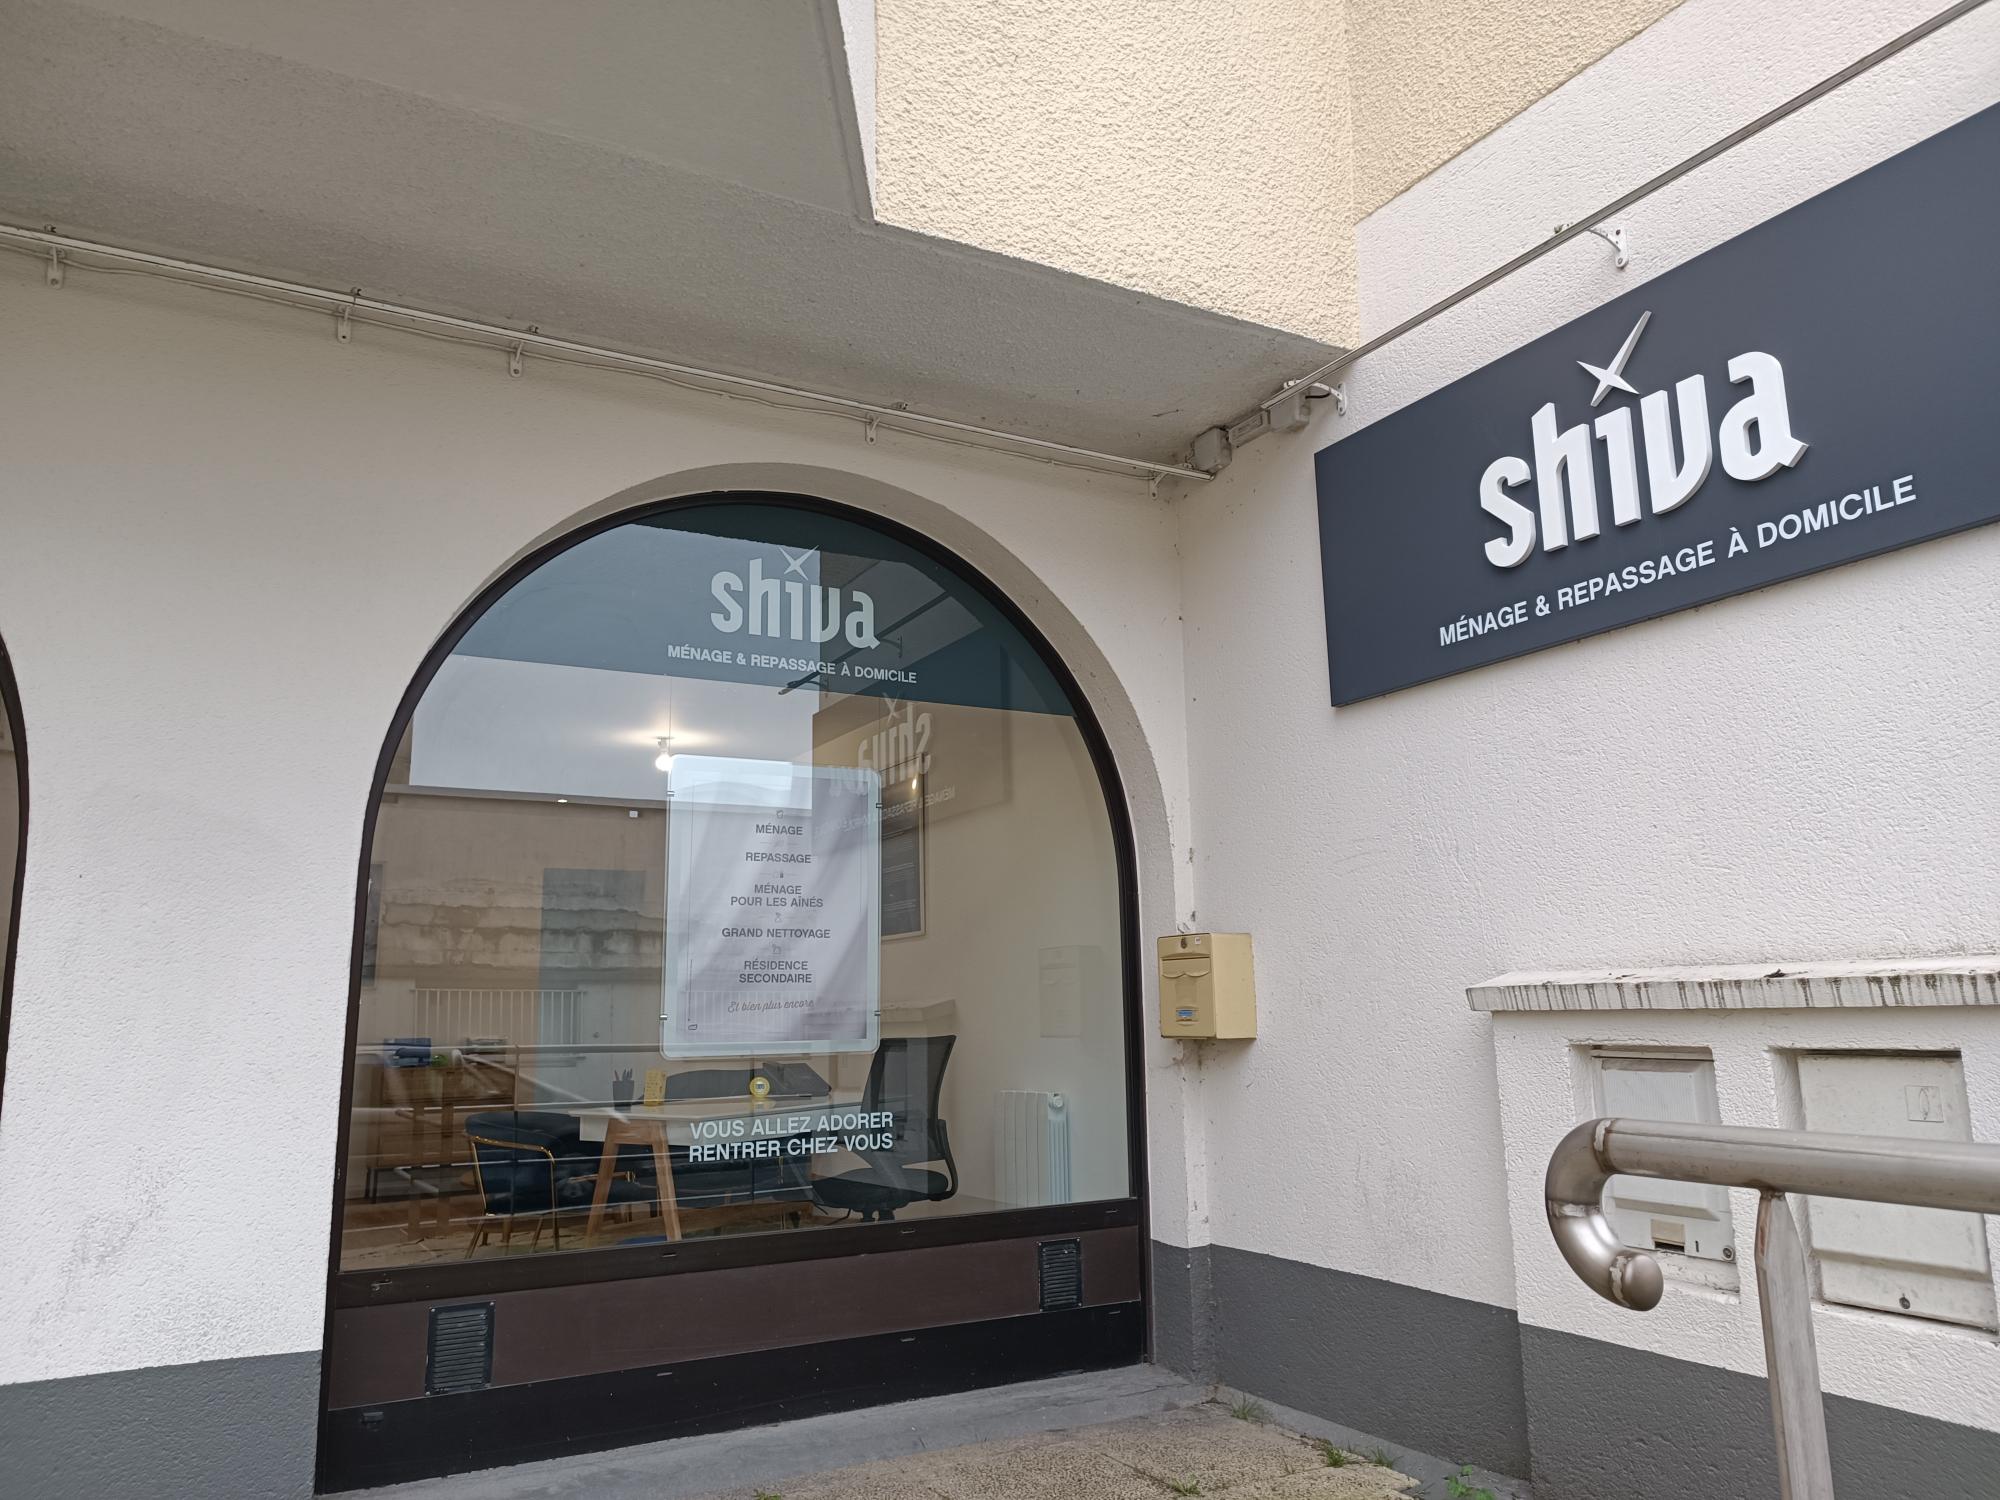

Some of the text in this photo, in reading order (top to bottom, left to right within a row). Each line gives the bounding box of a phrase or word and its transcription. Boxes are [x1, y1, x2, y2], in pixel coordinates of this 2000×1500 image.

[1479, 310, 1810, 568] shiva
[1438, 474, 1917, 647] MÉNAGE & REPASSAGE À DOMICILE
[710, 545, 881, 650] shiva
[667, 643, 918, 684] MÉNAGE & REPASSAGE À DOMICILE
[755, 822, 804, 836] MÉNAGE
[745, 851, 812, 865] REPASSAGE
[754, 882, 803, 896] MÉNAGE
[730, 896, 763, 907] POUR
[765, 896, 787, 907] LES
[721, 928, 832, 940] GRAND NETTOYAGE
[743, 958, 809, 971] RÉSIDENCE
[738, 972, 813, 984] SECONDAIRE
[741, 1000, 761, 1012] bien
[762, 999, 782, 1013] plus
[690, 1111, 893, 1140] VOUS ALLEZ ADORER
[689, 1133, 894, 1163] RENTRER CHEZ VOUS
